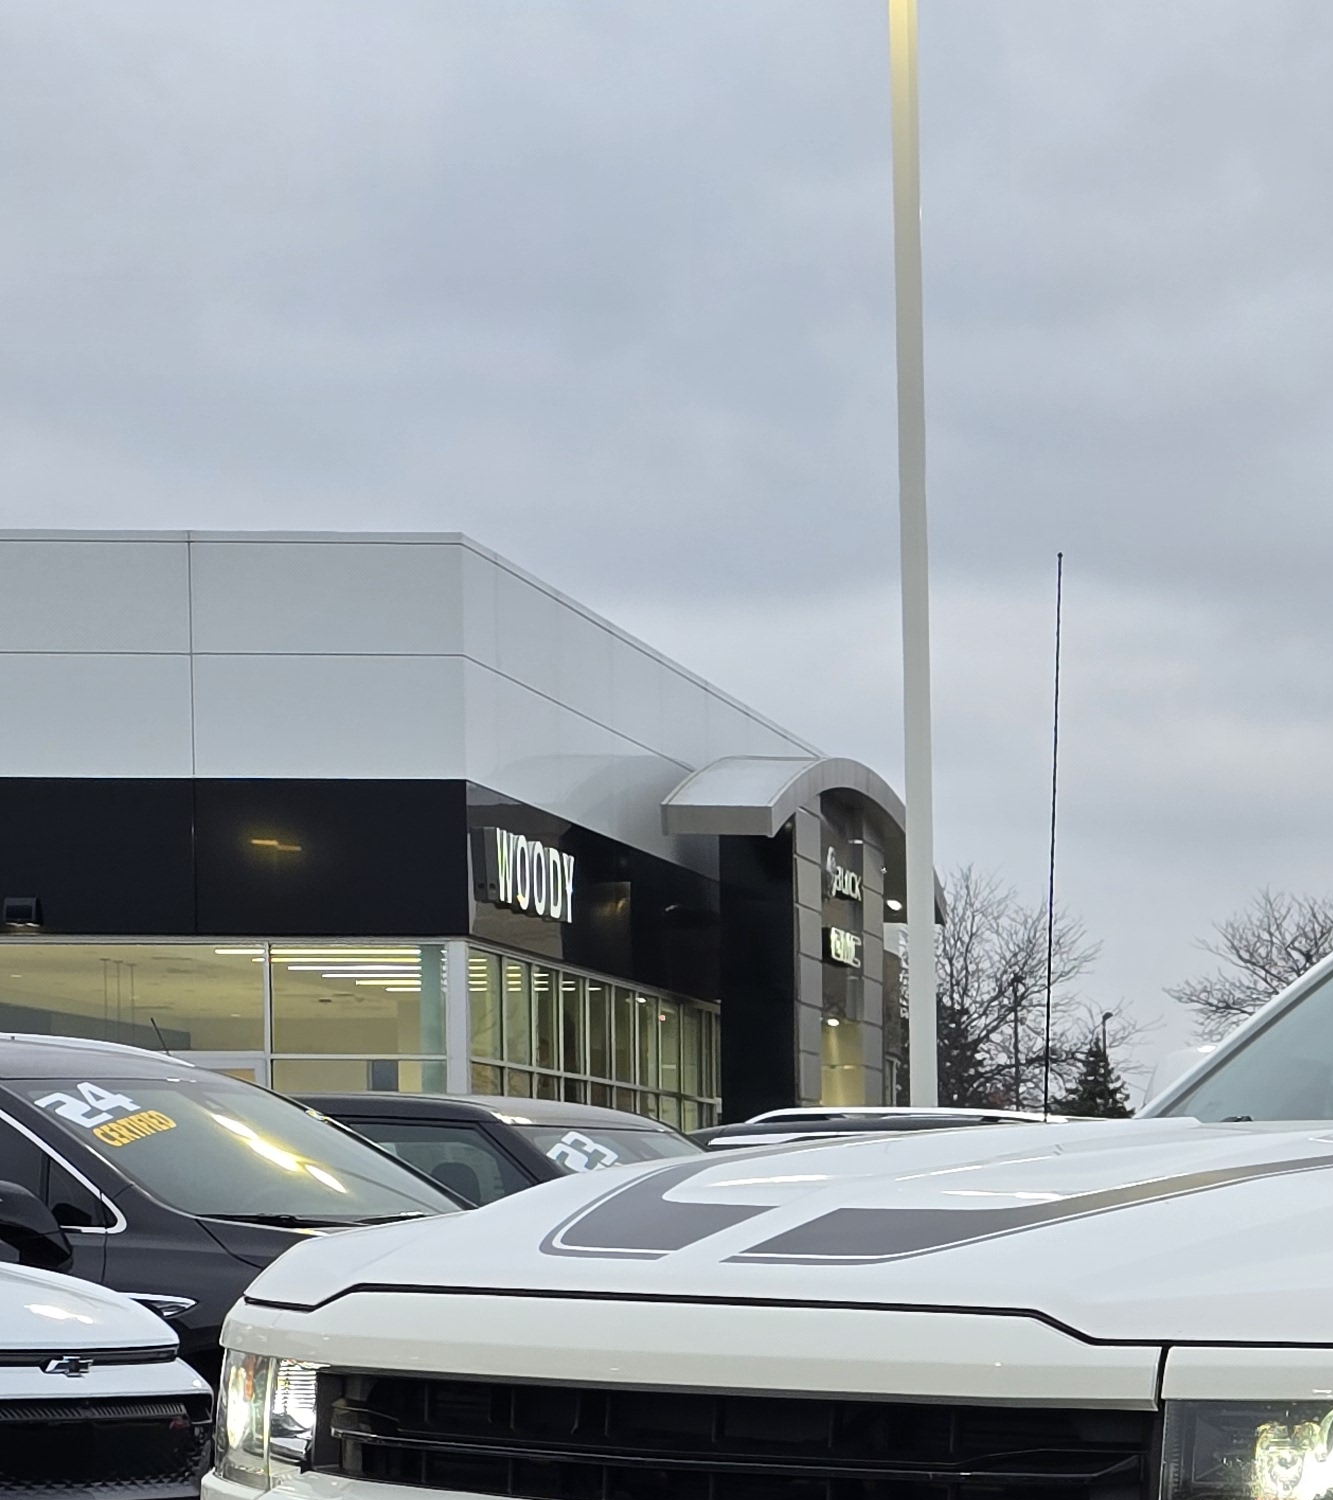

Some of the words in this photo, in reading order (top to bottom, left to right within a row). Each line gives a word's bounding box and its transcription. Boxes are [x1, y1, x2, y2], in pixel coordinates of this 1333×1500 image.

[496, 827, 575, 923] WOODY
[33, 1081, 142, 1129] 24
[92, 1109, 178, 1147] CERTIFIED
[545, 1130, 619, 1173] 23
